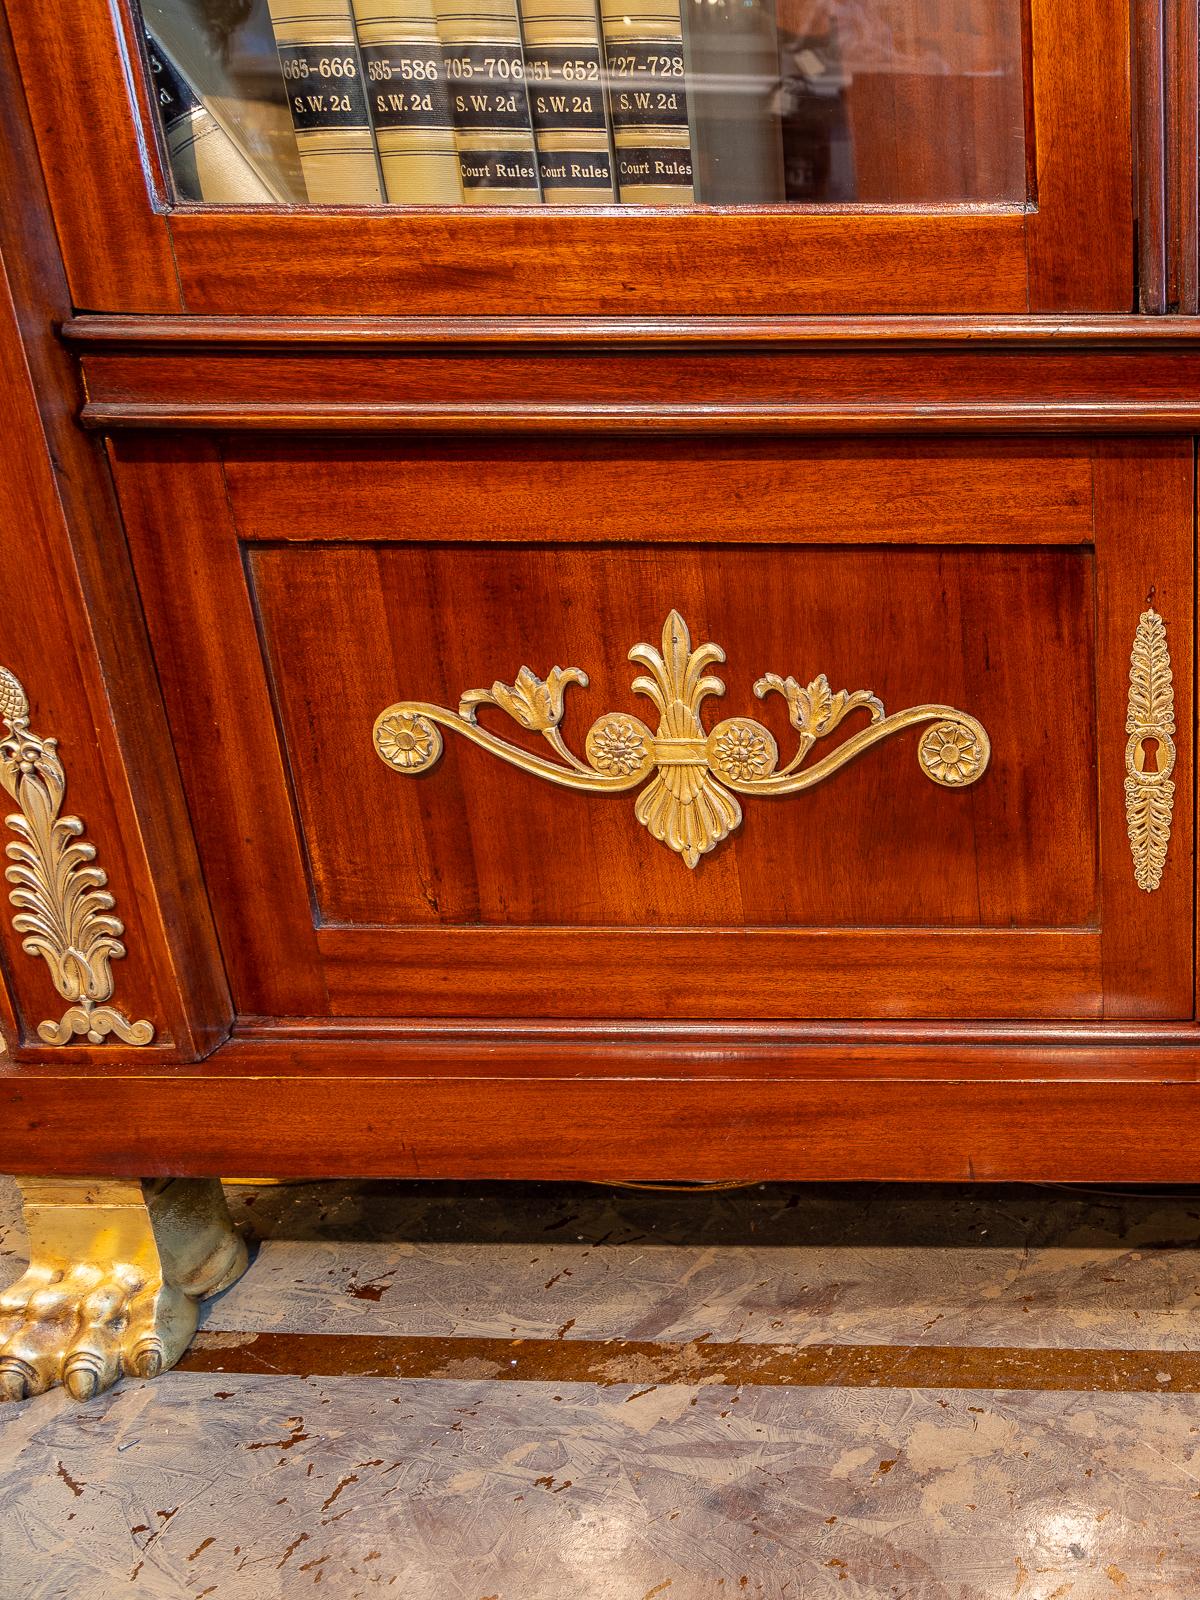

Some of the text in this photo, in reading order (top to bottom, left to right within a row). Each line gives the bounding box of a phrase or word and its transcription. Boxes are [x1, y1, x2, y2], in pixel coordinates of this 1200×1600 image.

[283, 57, 356, 80] 665-666
[367, 59, 438, 81] 585-586
[444, 58, 524, 79] 705-706
[608, 56, 685, 77] 727-728
[329, 95, 352, 112] 2d
[410, 94, 434, 111] 2d
[495, 95, 518, 112] 2d
[572, 96, 593, 113] 2d
[656, 93, 678, 110] 2d
[460, 163, 535, 178] Court Rules
[540, 164, 609, 178] Court Rules
[620, 160, 692, 175] Court Rules
